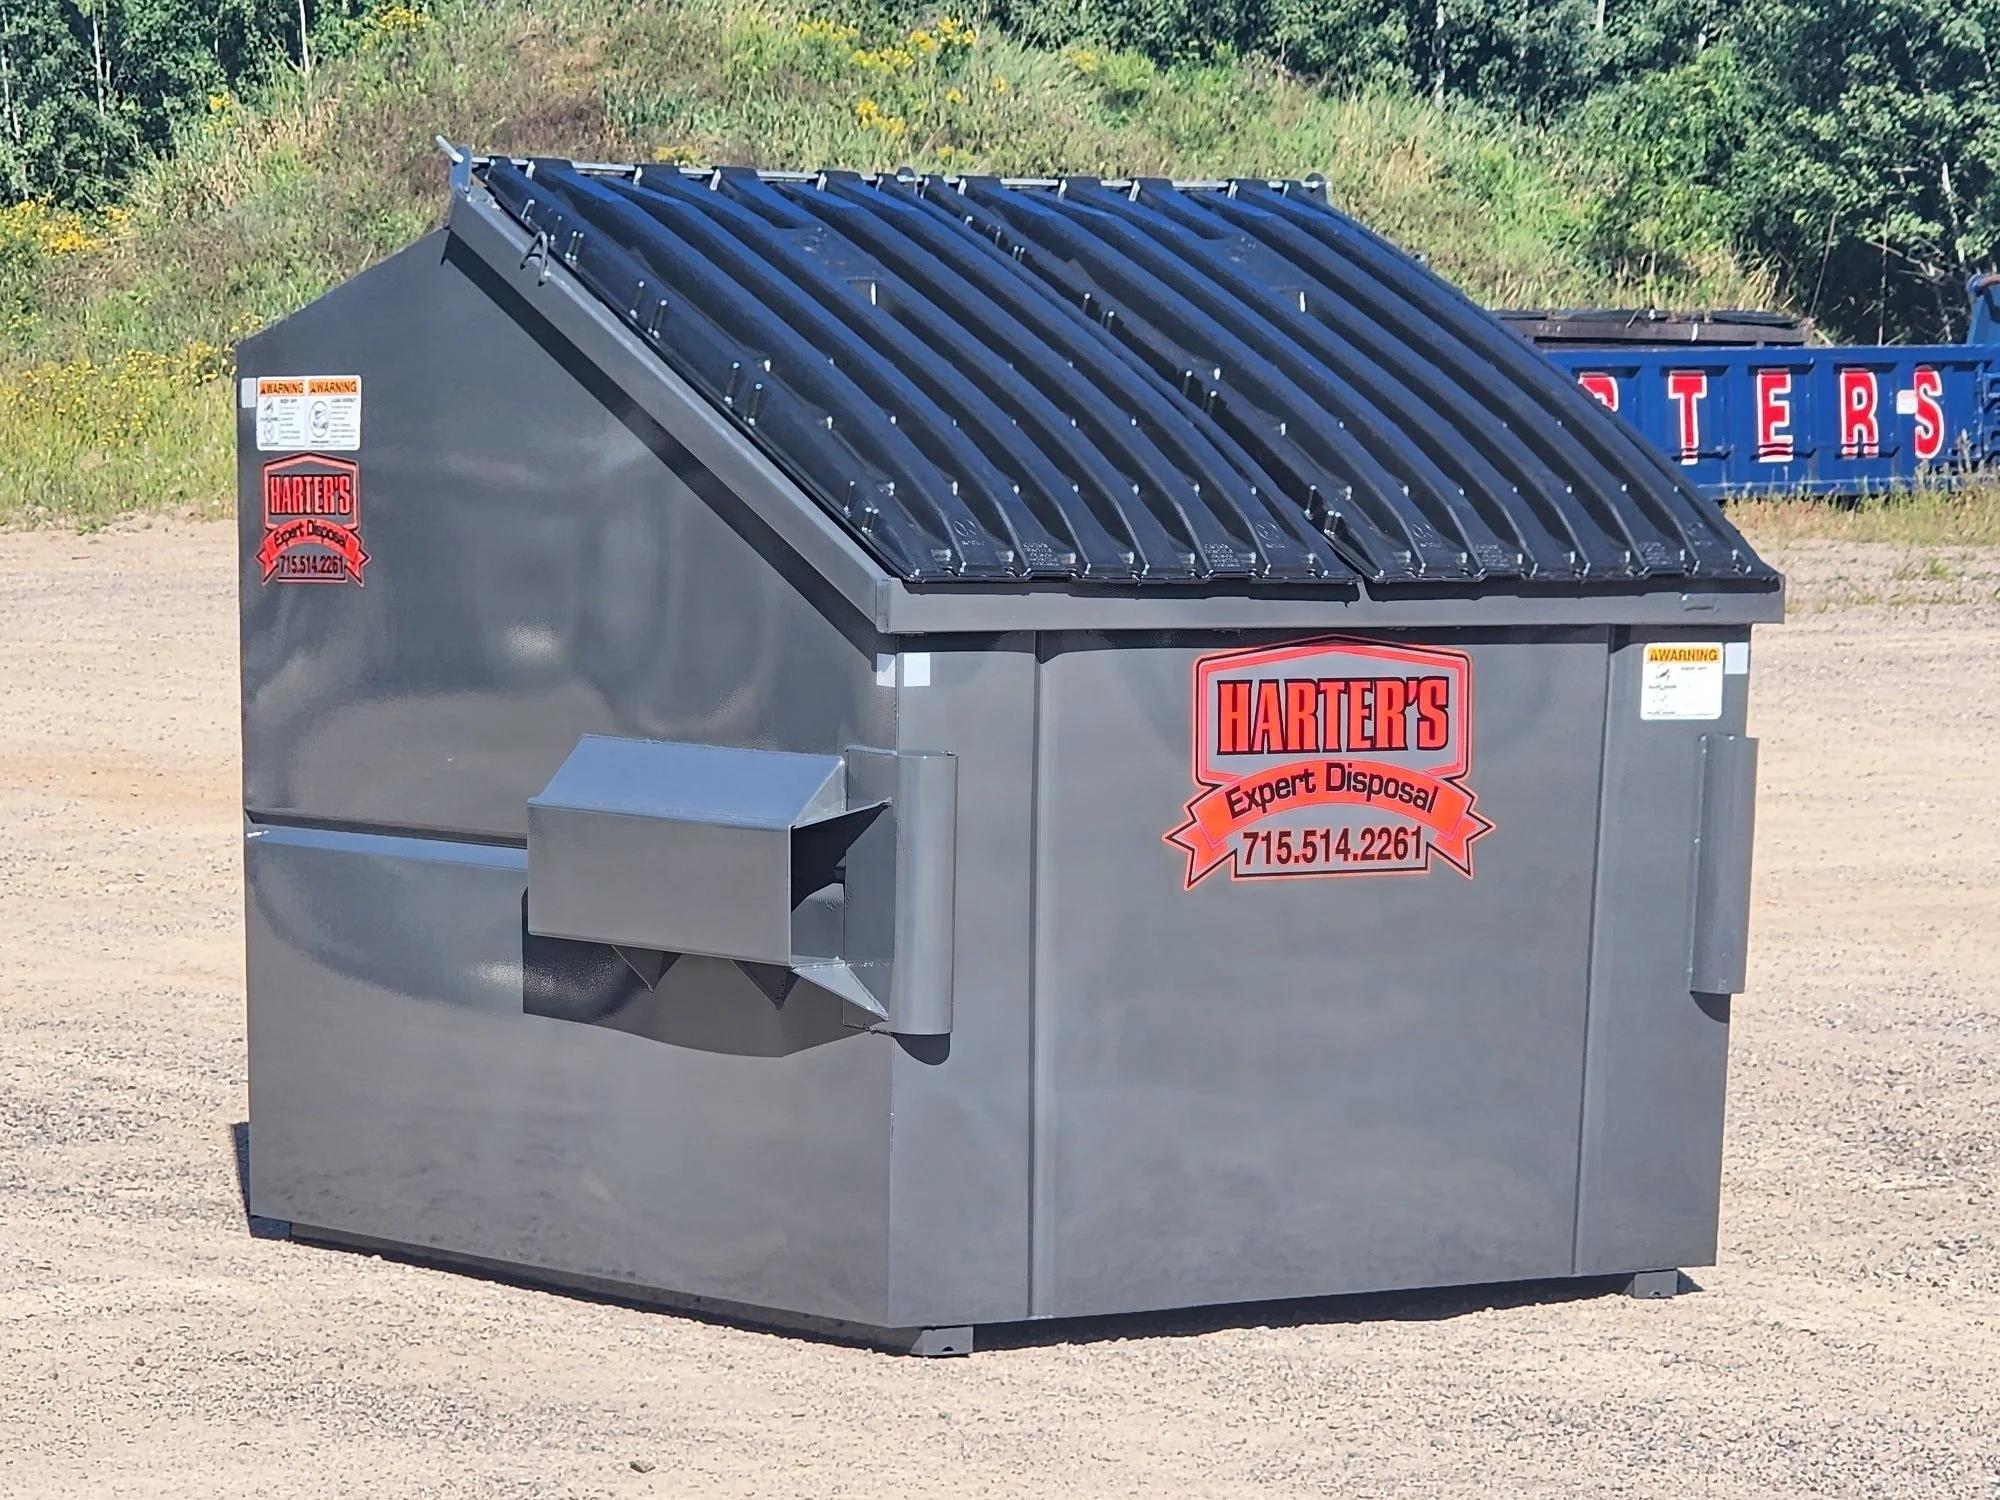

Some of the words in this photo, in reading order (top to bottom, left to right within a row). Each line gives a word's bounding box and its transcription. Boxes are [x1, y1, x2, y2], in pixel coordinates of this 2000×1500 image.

[266, 382, 304, 394] WARNING
[316, 381, 357, 394] WARNING
[269, 474, 351, 516] HARTER'S
[306, 518, 349, 549] Disposal
[279, 555, 345, 574] 715.514.2261
[1657, 648, 1718, 662] WARNING
[1217, 676, 1449, 756] HARTER'S
[1225, 768, 1317, 819] Expert
[1325, 762, 1440, 815] Disposal
[1242, 826, 1423, 866] 715.514.2261
